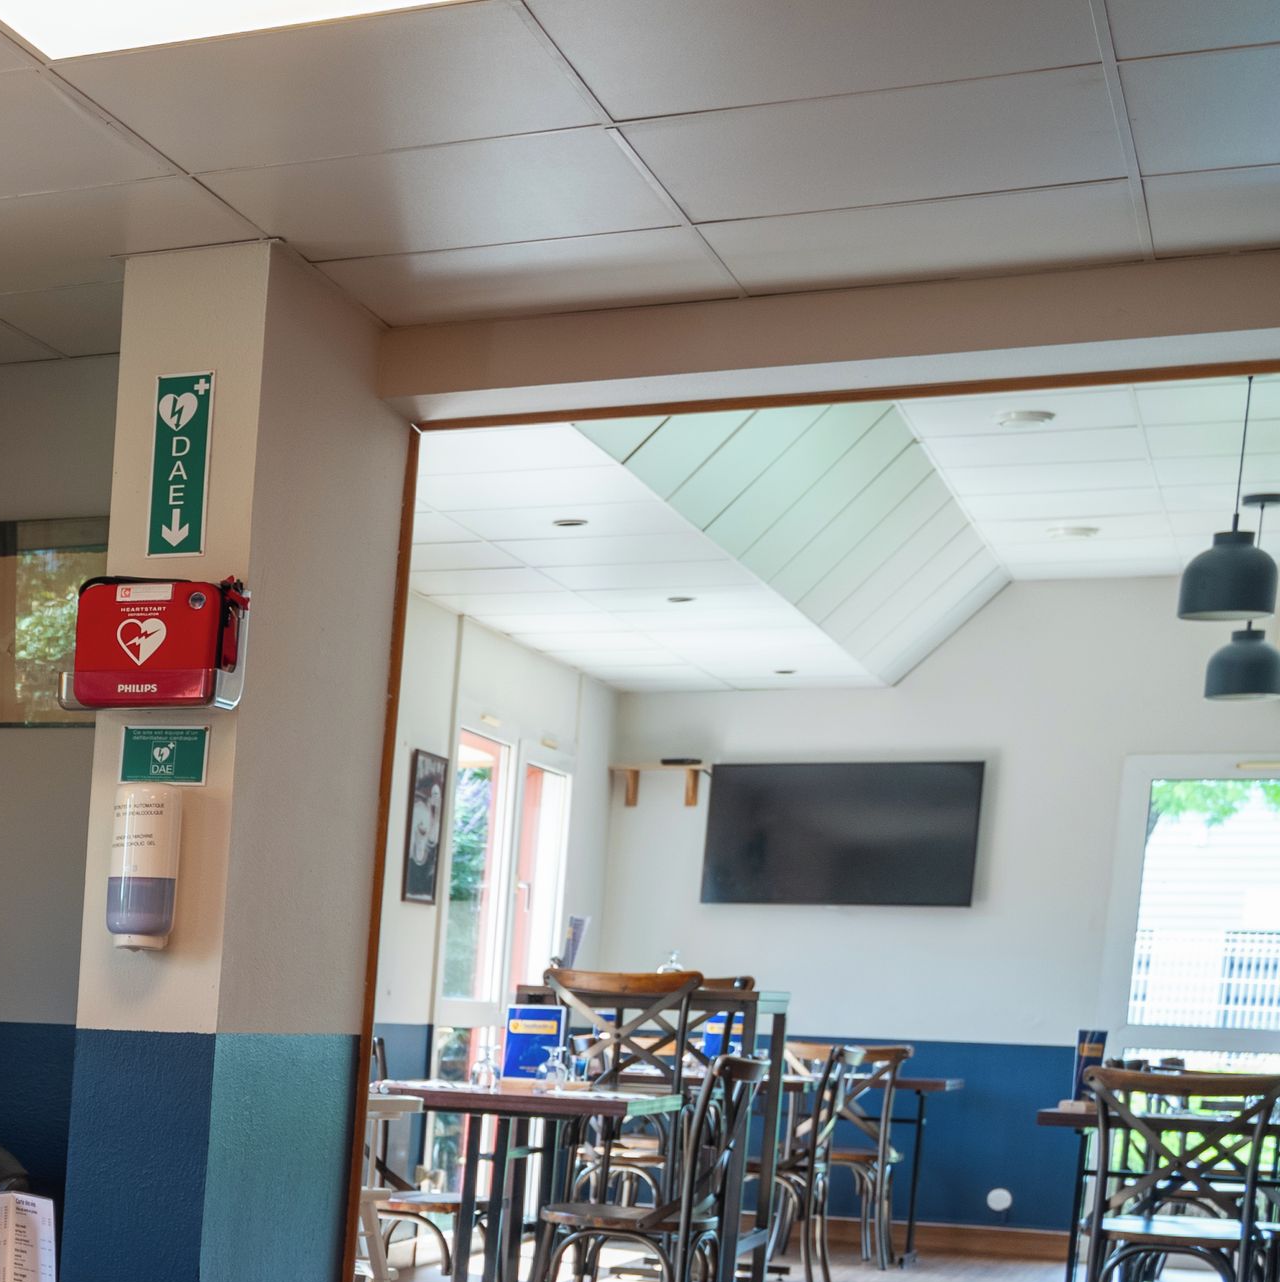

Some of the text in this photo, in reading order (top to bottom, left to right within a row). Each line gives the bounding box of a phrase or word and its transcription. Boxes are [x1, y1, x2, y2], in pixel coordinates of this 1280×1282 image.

[168, 436, 191, 505] DAE
[117, 683, 158, 693] PHILIPS
[151, 764, 173, 774] DAE
